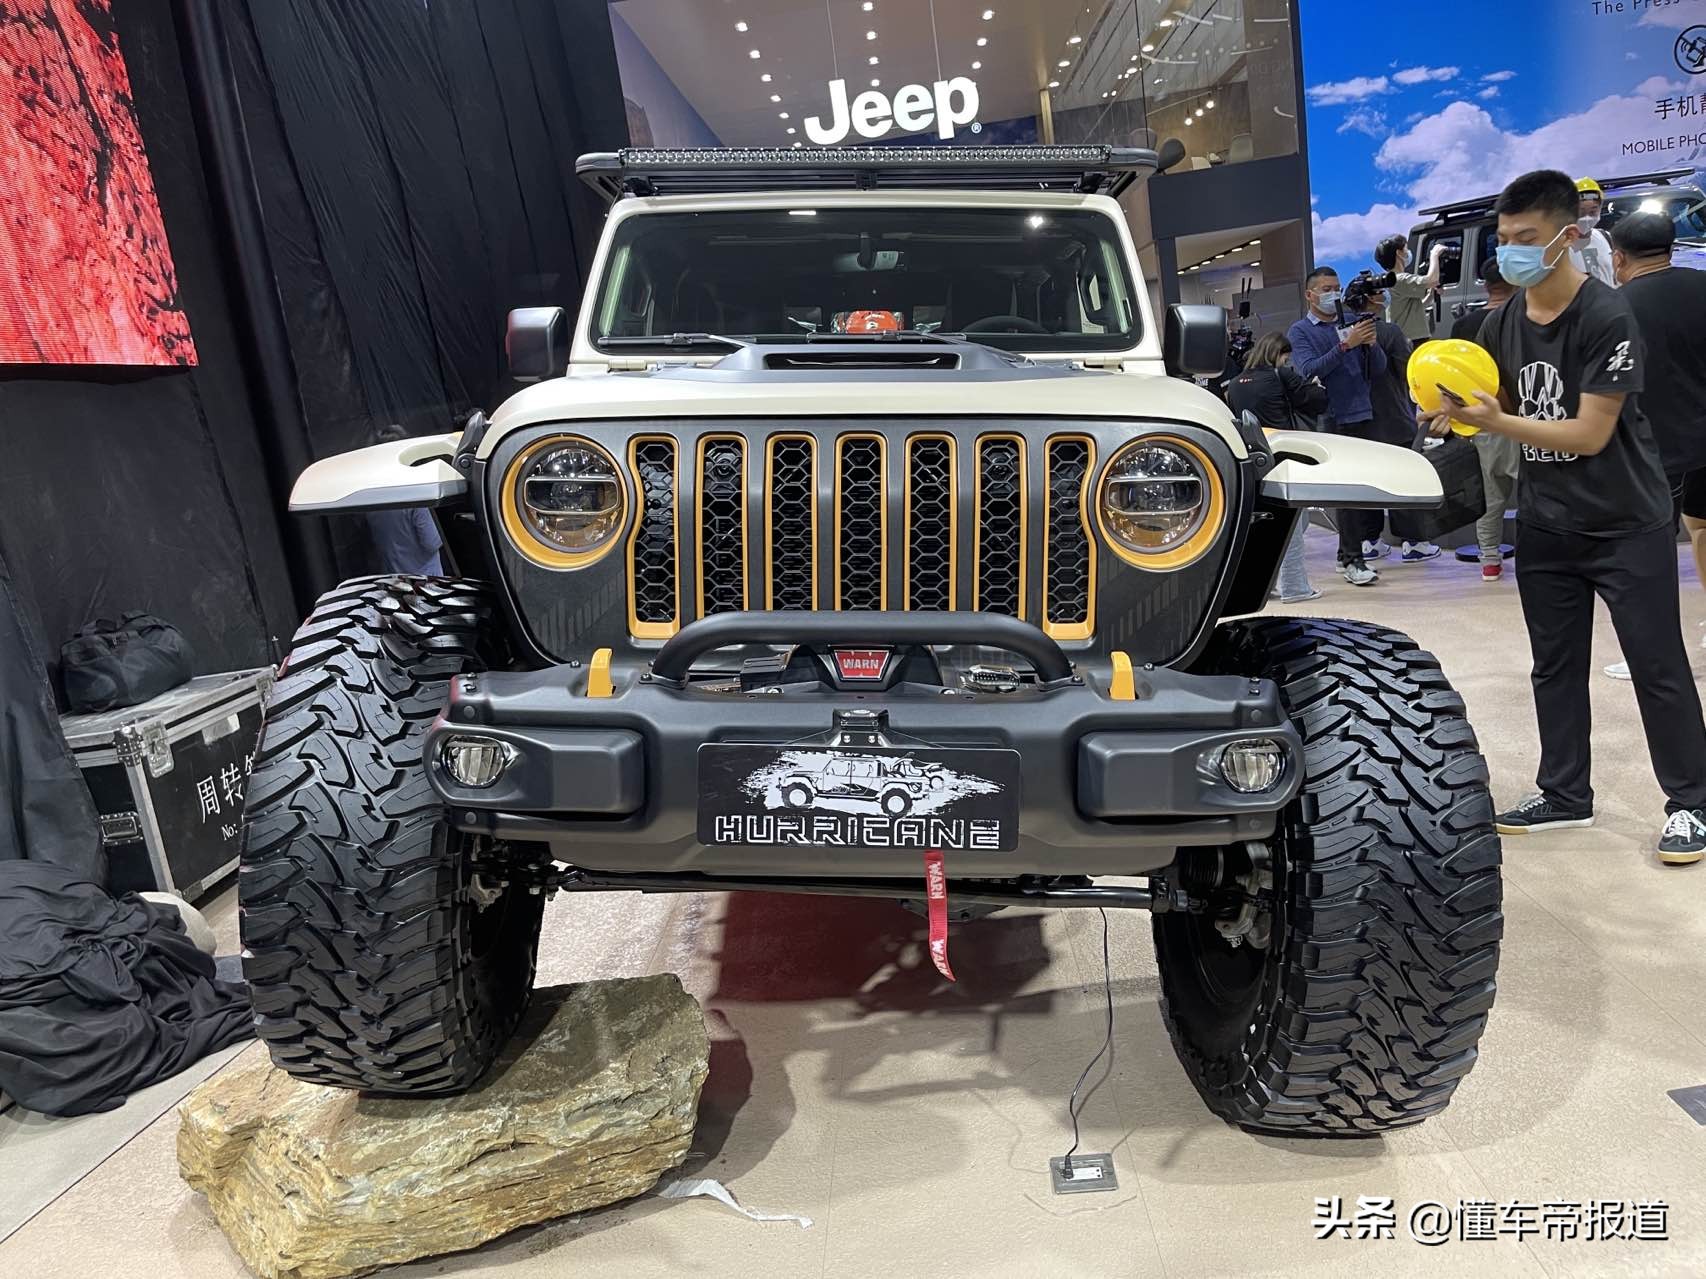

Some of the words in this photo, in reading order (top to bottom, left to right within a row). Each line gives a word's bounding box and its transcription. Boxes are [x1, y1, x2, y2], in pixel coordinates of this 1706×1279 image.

[1592, 1, 1624, 15] The
[1622, 137, 1675, 155] MOBILE
[843, 658, 879, 669] WARN
[714, 815, 1000, 850] HURRICANE
[928, 861, 945, 899] WARN
